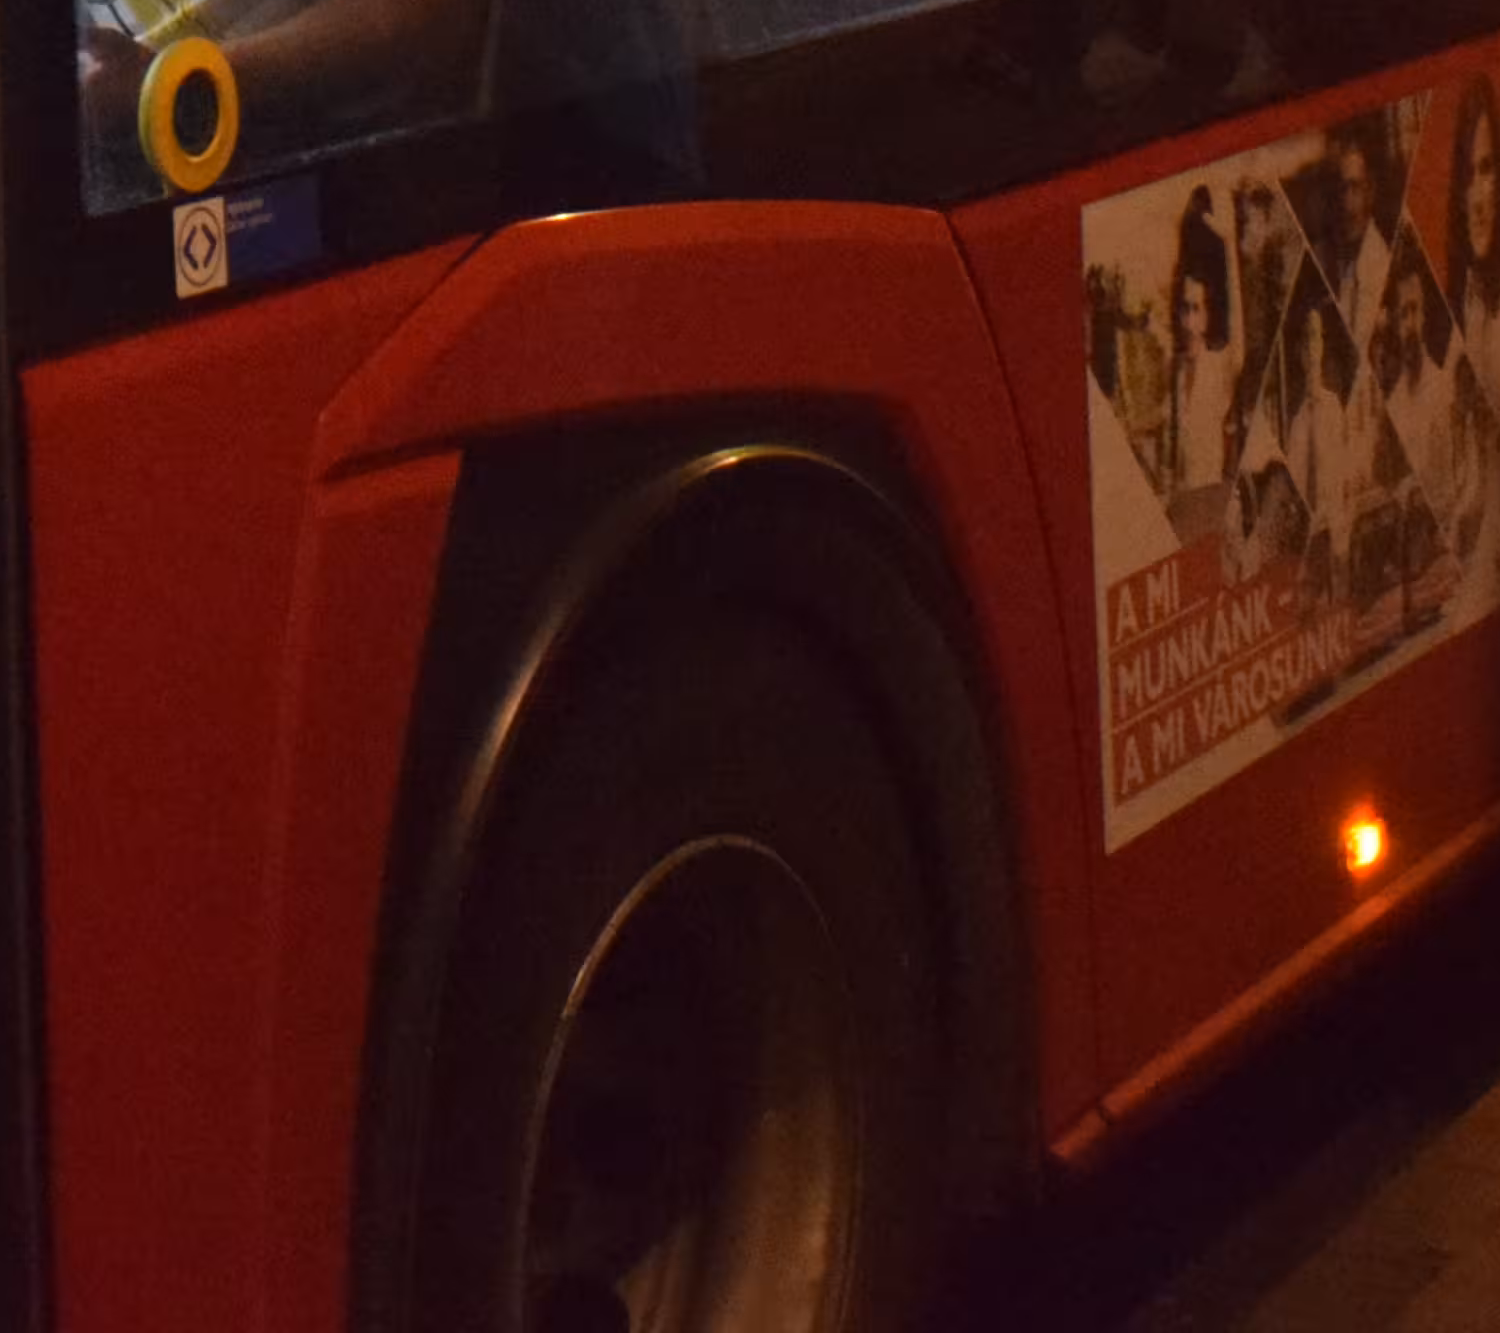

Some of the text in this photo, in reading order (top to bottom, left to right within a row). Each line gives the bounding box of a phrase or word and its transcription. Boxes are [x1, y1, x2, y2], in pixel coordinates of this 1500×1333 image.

[1114, 560, 1181, 643] A MI
[1116, 586, 1274, 721] MUNKÁNK
[1121, 610, 1352, 795] A MI VÁROSUNK!
